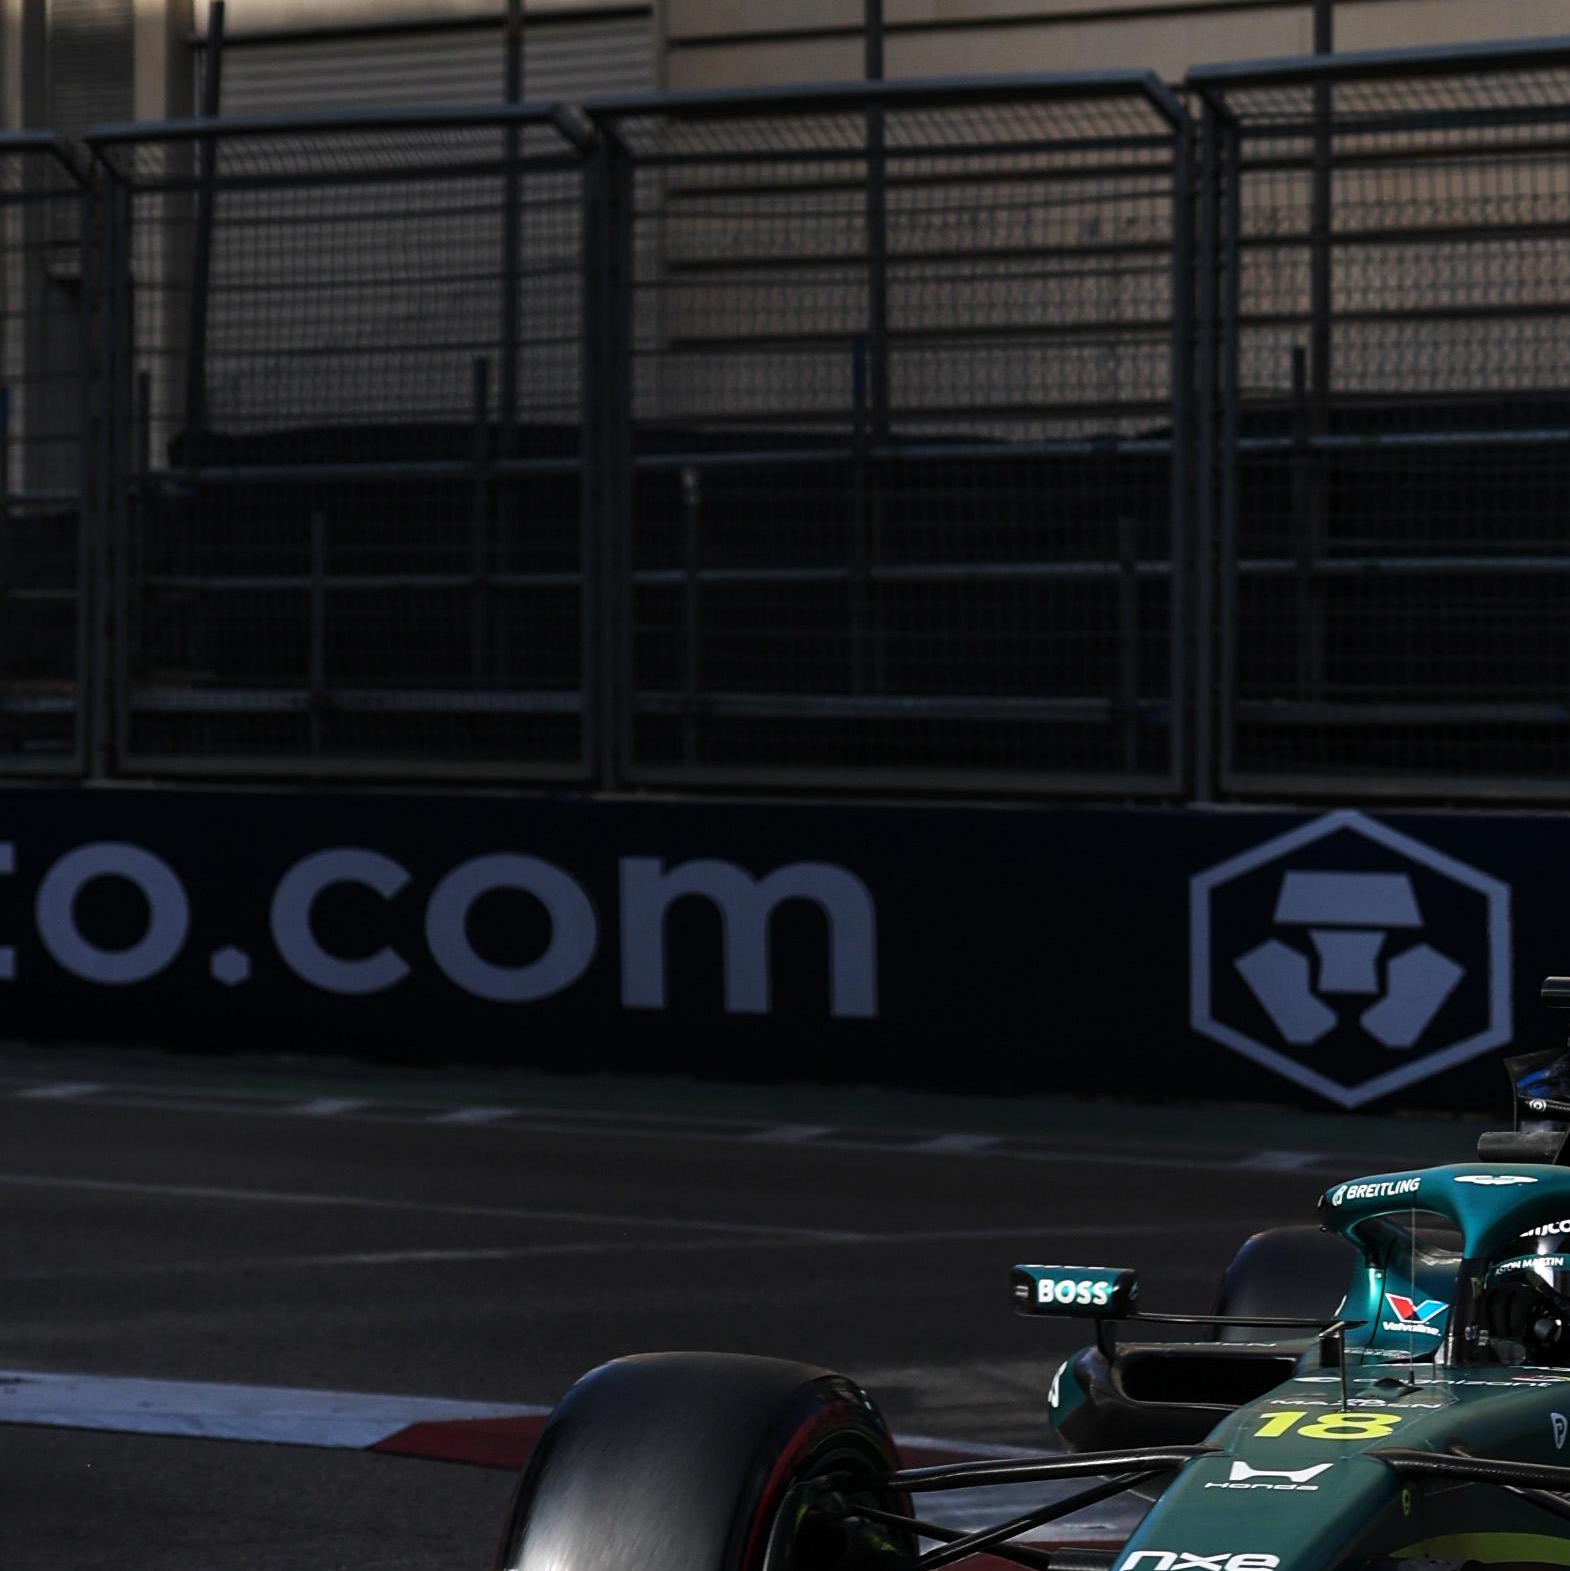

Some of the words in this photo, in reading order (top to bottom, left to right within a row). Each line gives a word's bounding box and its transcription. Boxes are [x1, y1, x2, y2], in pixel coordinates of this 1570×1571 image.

[0, 841, 879, 1019] o.com
[1346, 1176, 1421, 1200] BREITLING
[1494, 1259, 1521, 1277] ASTON
[1521, 1256, 1565, 1269] MARTIN
[1037, 1278, 1109, 1306] BOSS
[1252, 1410, 1402, 1440] 18
[1204, 1481, 1320, 1492] Honda
